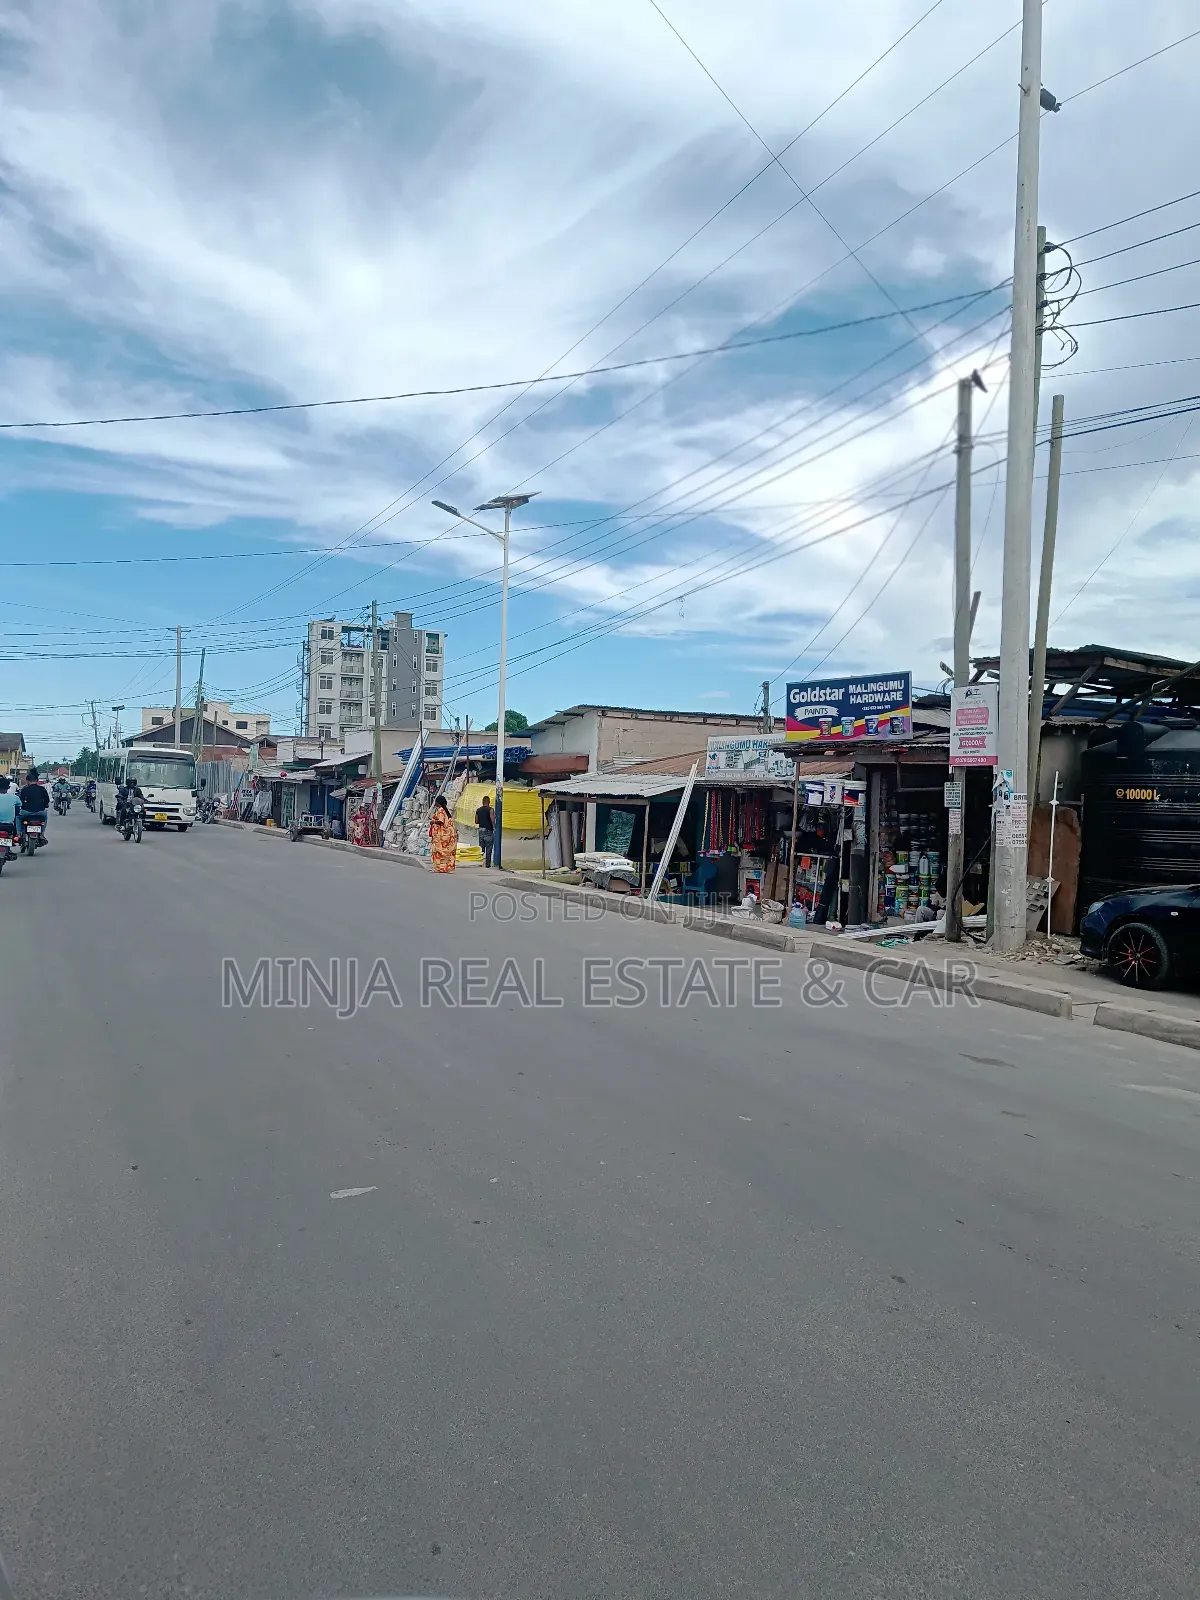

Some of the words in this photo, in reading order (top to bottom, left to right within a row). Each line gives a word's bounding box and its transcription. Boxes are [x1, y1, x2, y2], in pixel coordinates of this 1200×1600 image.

[848, 680, 905, 694] MALINGUMU
[789, 686, 845, 703] Goldstar
[850, 690, 903, 704] HARDWARE
[804, 707, 829, 716] PAINTS
[1125, 788, 1152, 800] 10000
